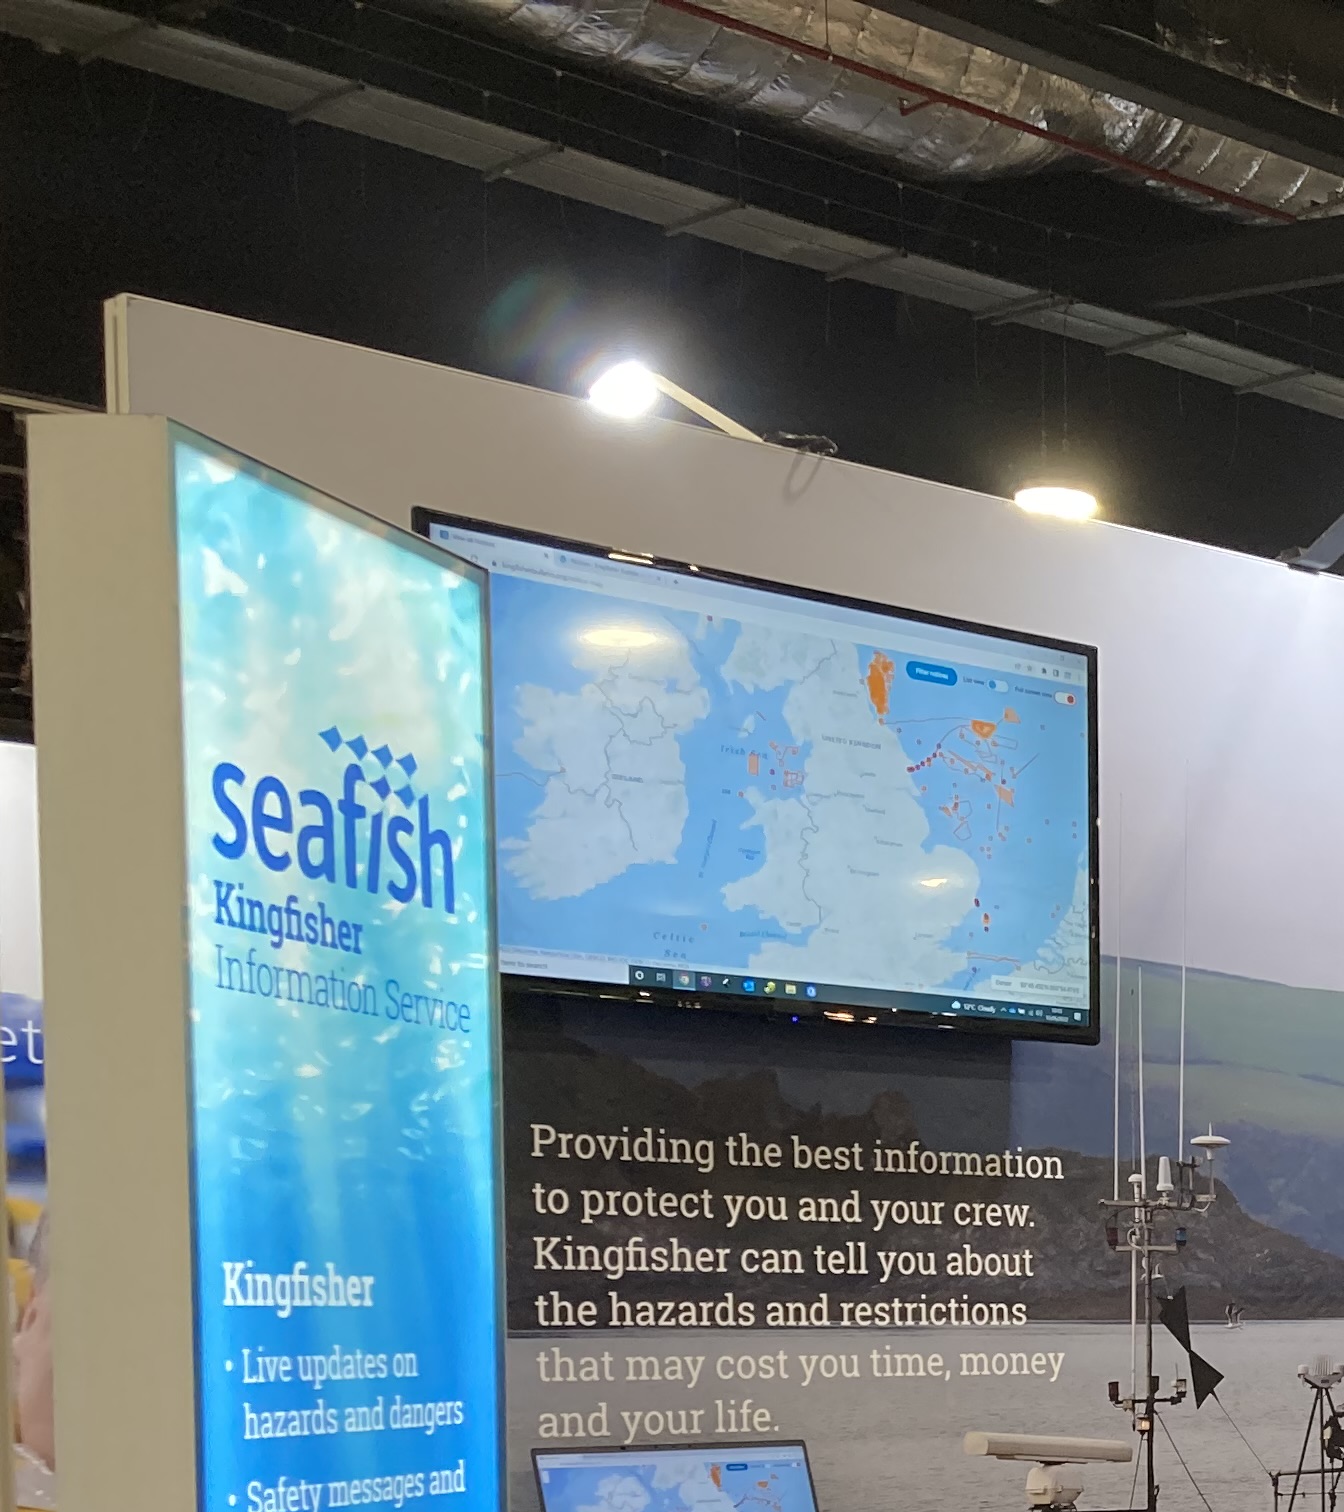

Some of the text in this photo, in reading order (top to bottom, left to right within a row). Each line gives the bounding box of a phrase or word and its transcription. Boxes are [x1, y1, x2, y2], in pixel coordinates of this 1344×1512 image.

[721, 745, 745, 755] Irish
[212, 762, 455, 914] seafish
[214, 880, 363, 954] Kingfisher
[653, 930, 695, 944] Celtic
[664, 948, 687, 960] Sea
[215, 944, 471, 1033] Information Service
[530, 1123, 1064, 1180] Providing the best information
[532, 1183, 1035, 1231] to protect you and your crew.
[533, 1236, 1034, 1283] Kingfisher can tell you about
[222, 1260, 375, 1318] Kingfisher
[534, 1291, 1027, 1327] the hazards and restrictions
[242, 1345, 418, 1390] Live updates on
[536, 1345, 1065, 1388] that may cost you time, money
[244, 1395, 464, 1440] hazards and dangers
[539, 1400, 779, 1444] and your life.
[328, 1470, 424, 1508] messages
[429, 1459, 466, 1495] and
